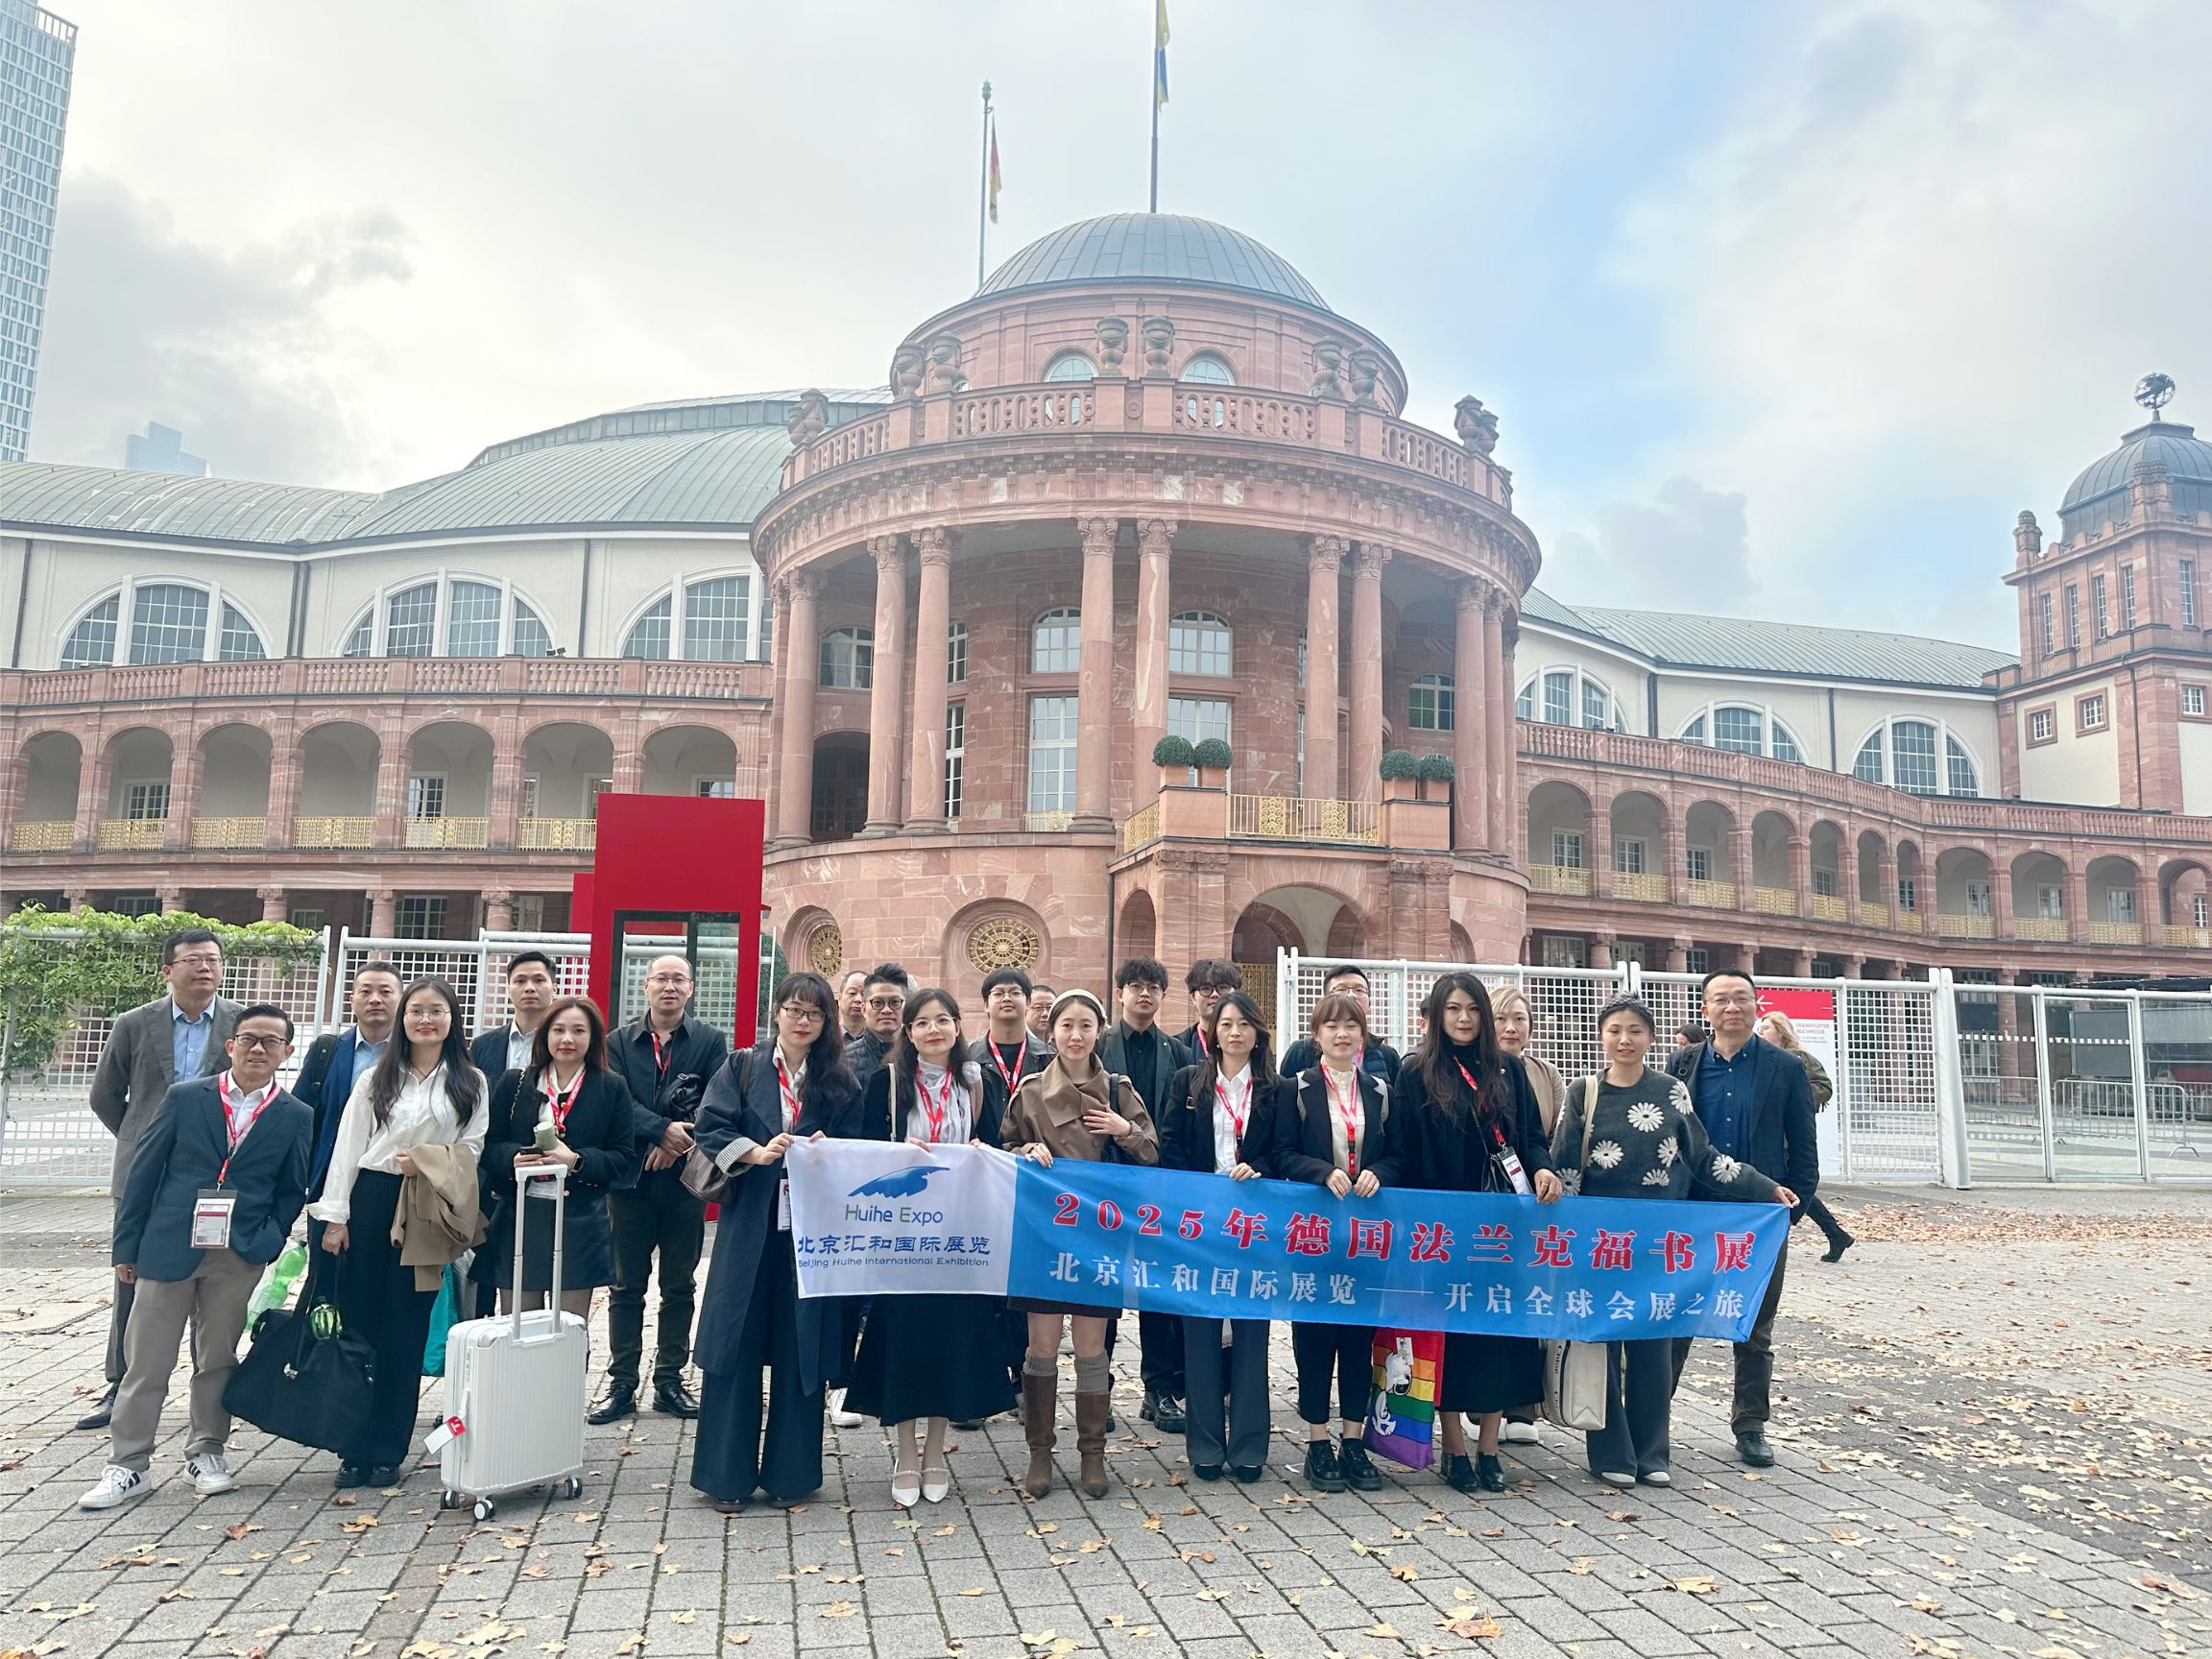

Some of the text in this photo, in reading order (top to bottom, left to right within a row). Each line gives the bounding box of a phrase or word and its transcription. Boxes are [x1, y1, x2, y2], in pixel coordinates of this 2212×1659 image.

[844, 1204, 944, 1227] Huihe Expo
[1052, 1190, 1756, 1274] 2025年德国法兰克福书展
[798, 1235, 991, 1256] 北京汇和国际展览
[798, 1260, 829, 1268] Beijing
[865, 1257, 933, 1265] International
[936, 1257, 989, 1266] Exhibition
